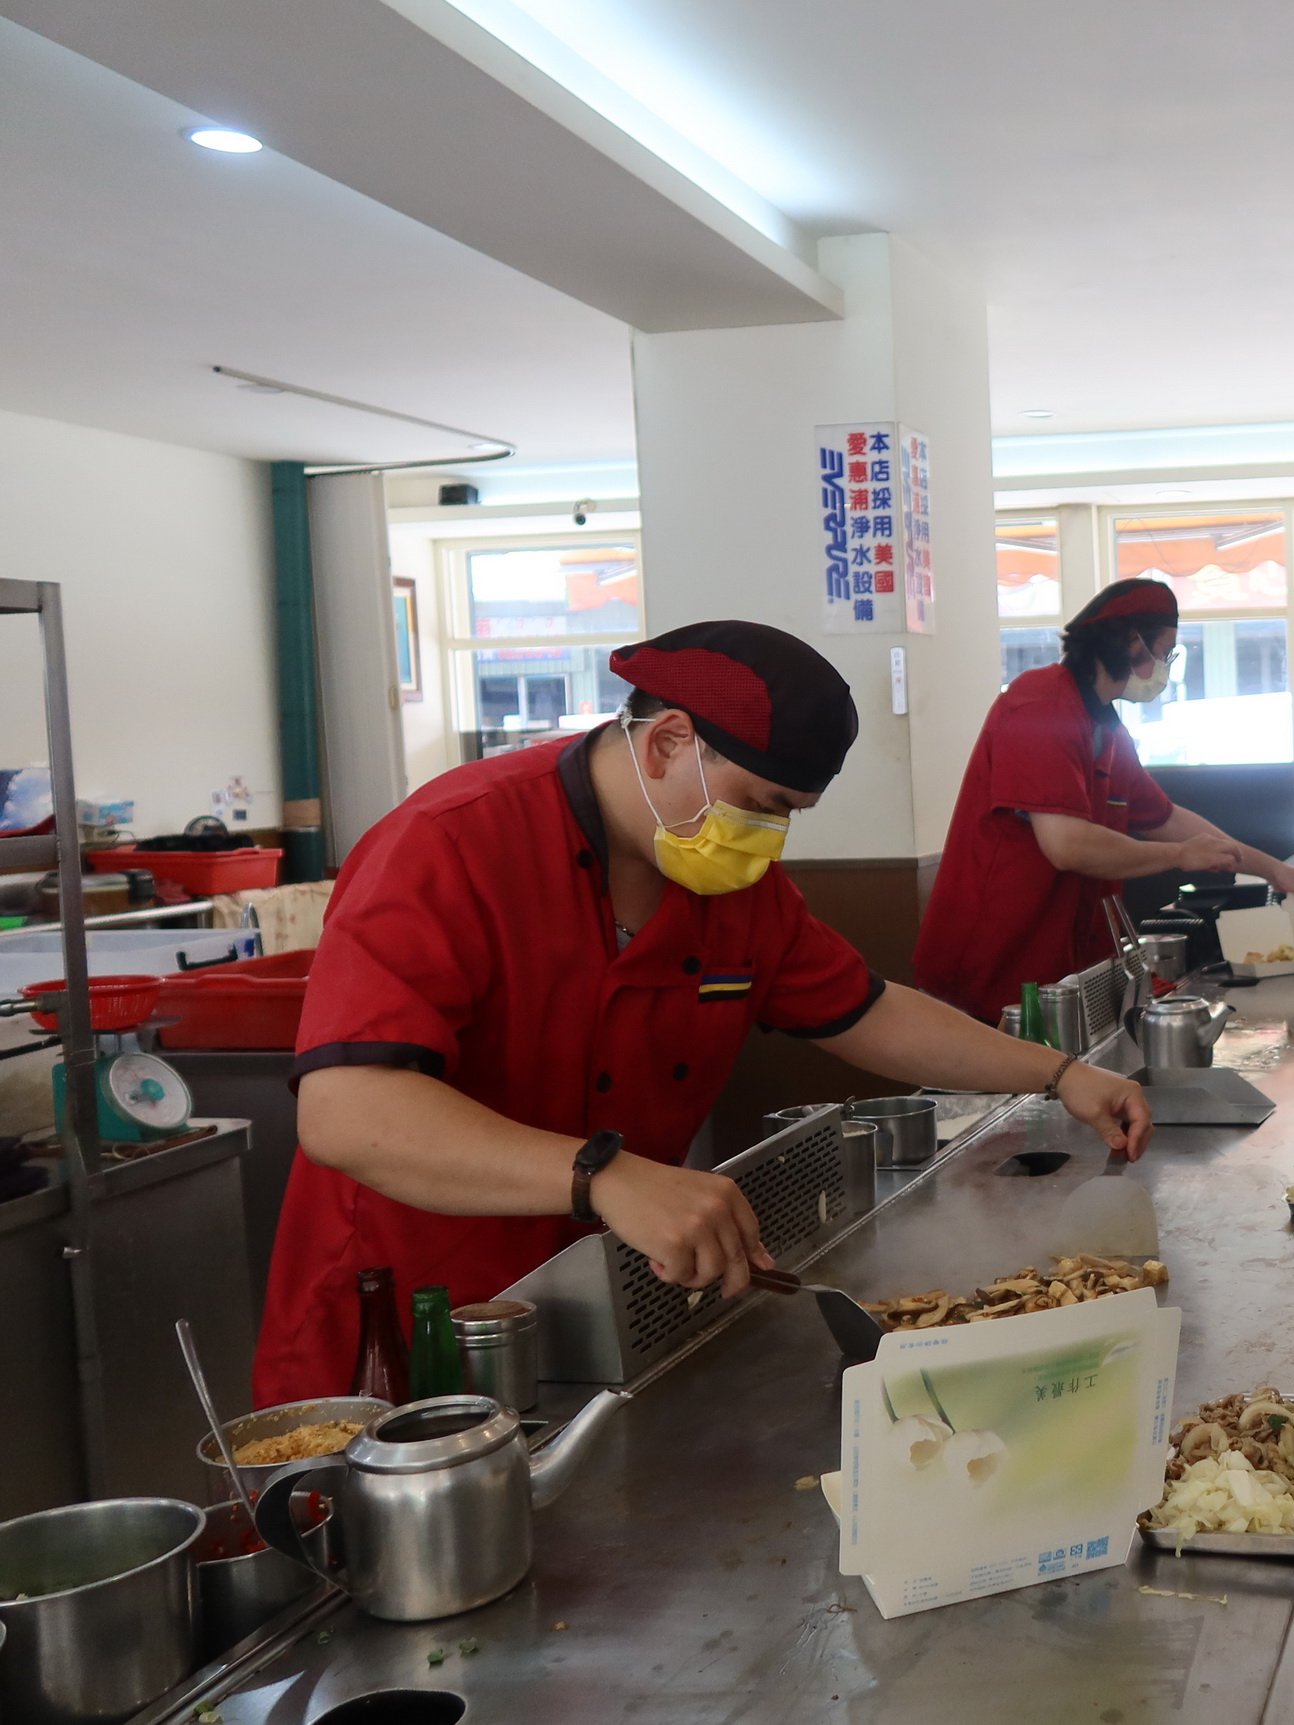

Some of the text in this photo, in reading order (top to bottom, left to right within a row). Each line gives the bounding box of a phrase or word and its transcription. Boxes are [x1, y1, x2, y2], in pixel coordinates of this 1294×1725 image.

[820, 447, 850, 601] EVERPURE
[847, 432, 874, 621] 愛惠浦淨水設備
[869, 431, 894, 593] 本店採用美國
[1033, 1374, 1098, 1402] 工作最美
